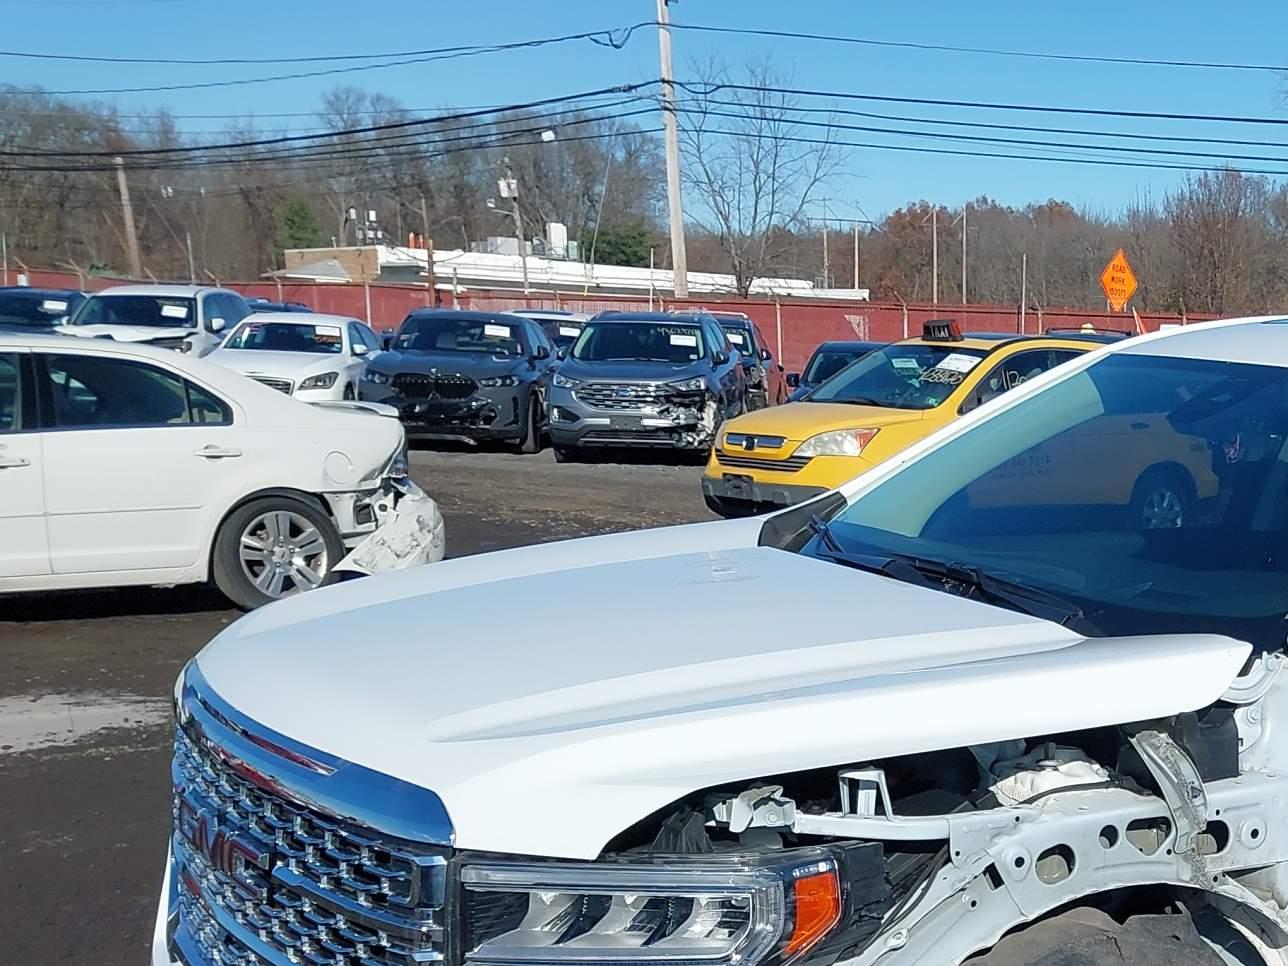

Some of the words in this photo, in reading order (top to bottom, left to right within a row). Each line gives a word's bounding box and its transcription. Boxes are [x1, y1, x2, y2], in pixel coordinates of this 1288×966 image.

[1111, 263, 1127, 274] ROAD
[1110, 275, 1126, 286] WORK
[929, 326, 949, 338] TAXI
[179, 795, 270, 901] GMC
